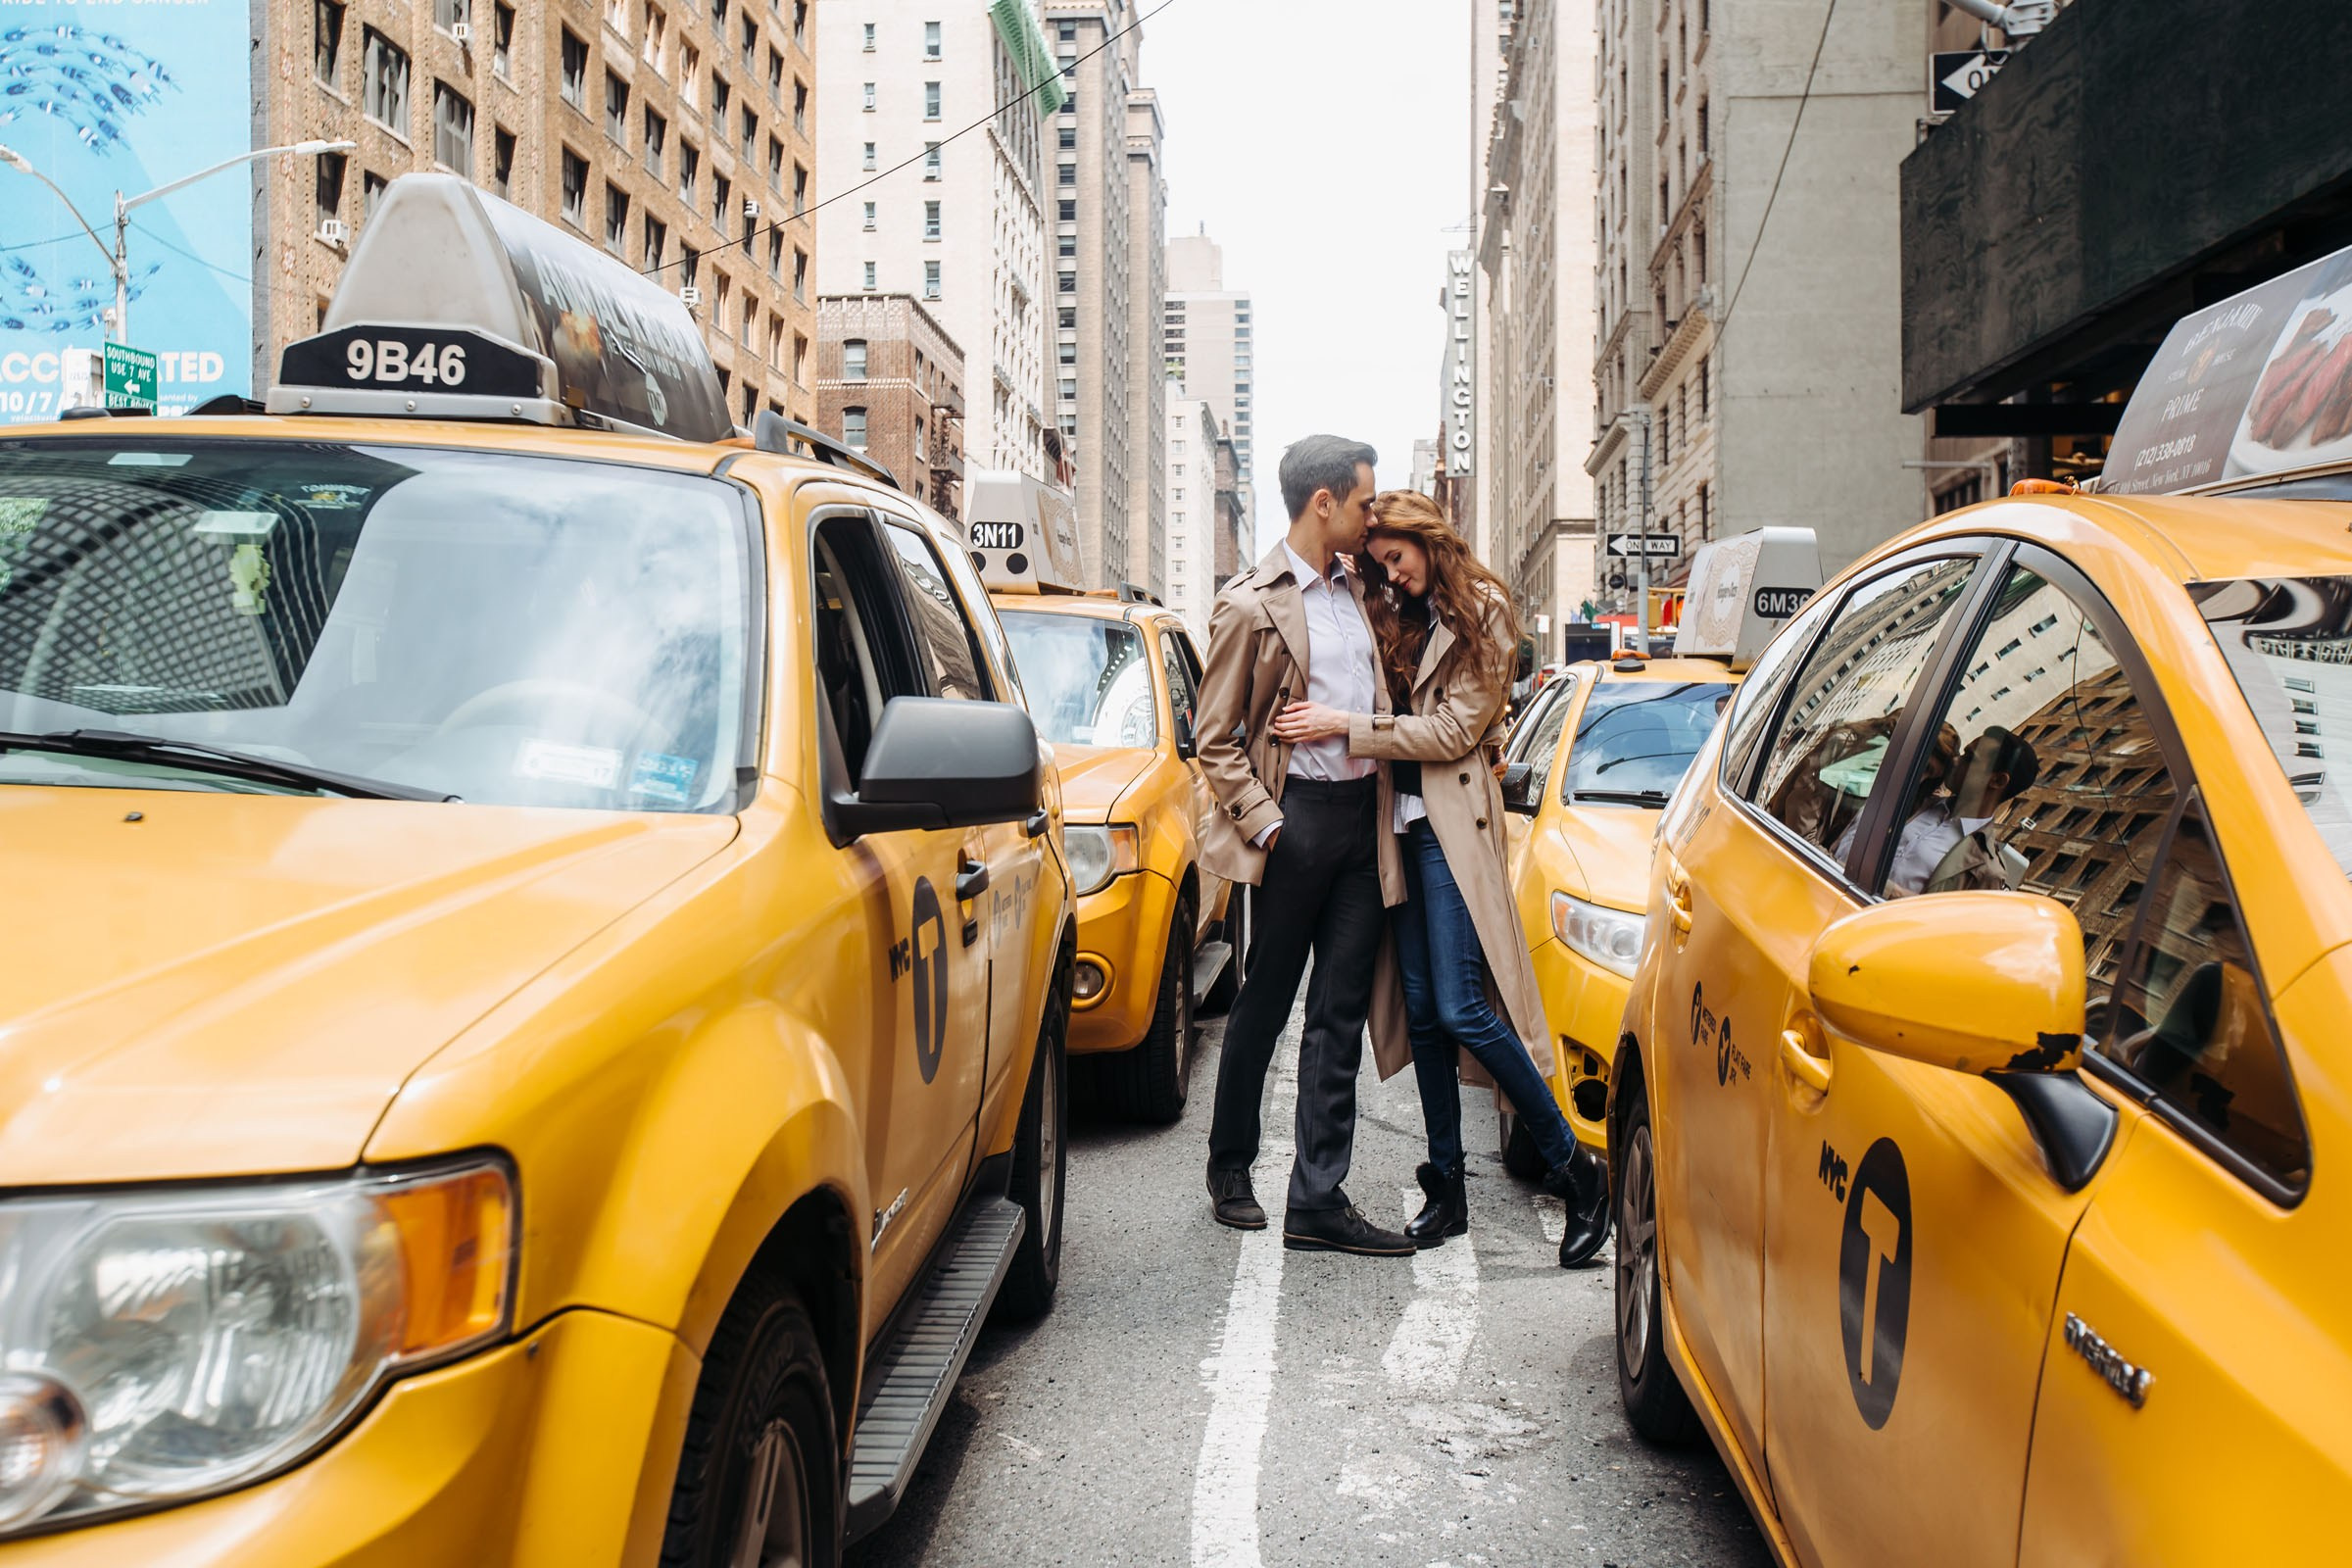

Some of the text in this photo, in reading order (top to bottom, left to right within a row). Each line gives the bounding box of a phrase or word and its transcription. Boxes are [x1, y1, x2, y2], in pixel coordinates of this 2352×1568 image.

[106, 345, 156, 369] SOUTHBOUND
[111, 360, 152, 382] USE 7 AVE
[346, 338, 466, 386] 9B46
[1450, 255, 1474, 475] WELLINGTON
[108, 393, 127, 408] BEST
[2161, 388, 2205, 422] PRIME
[972, 523, 1017, 548] 3N11
[1650, 540, 1672, 550] WAY
[888, 937, 910, 984] NYC
[1819, 1139, 1848, 1204] NYC
